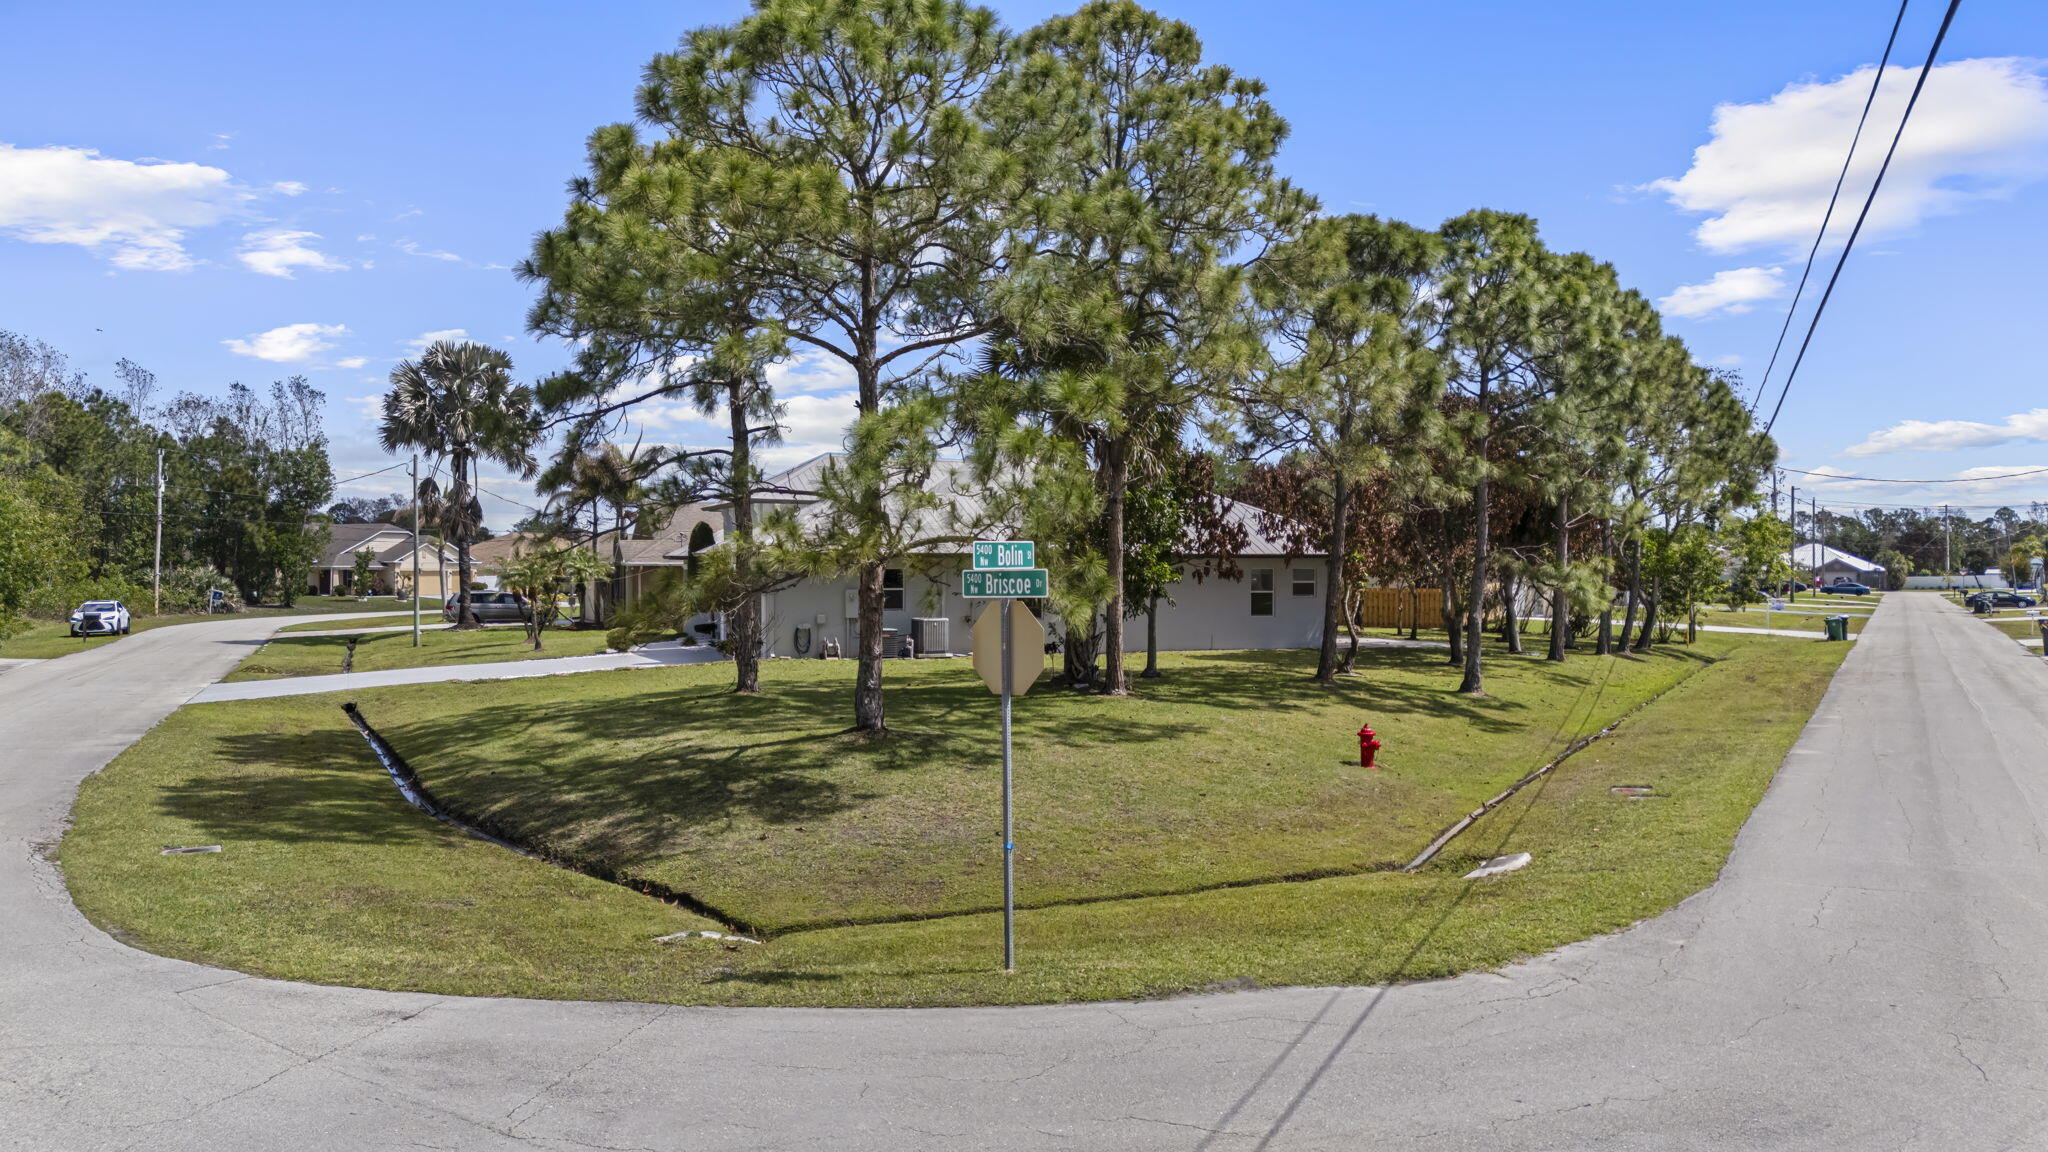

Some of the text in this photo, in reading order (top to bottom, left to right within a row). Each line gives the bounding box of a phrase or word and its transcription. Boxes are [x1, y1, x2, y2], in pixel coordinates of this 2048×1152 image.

[976, 544, 993, 555] 5400
[998, 544, 1024, 566] Bolin
[966, 573, 982, 583] 5400
[985, 573, 1042, 594] Briscoe Dr
